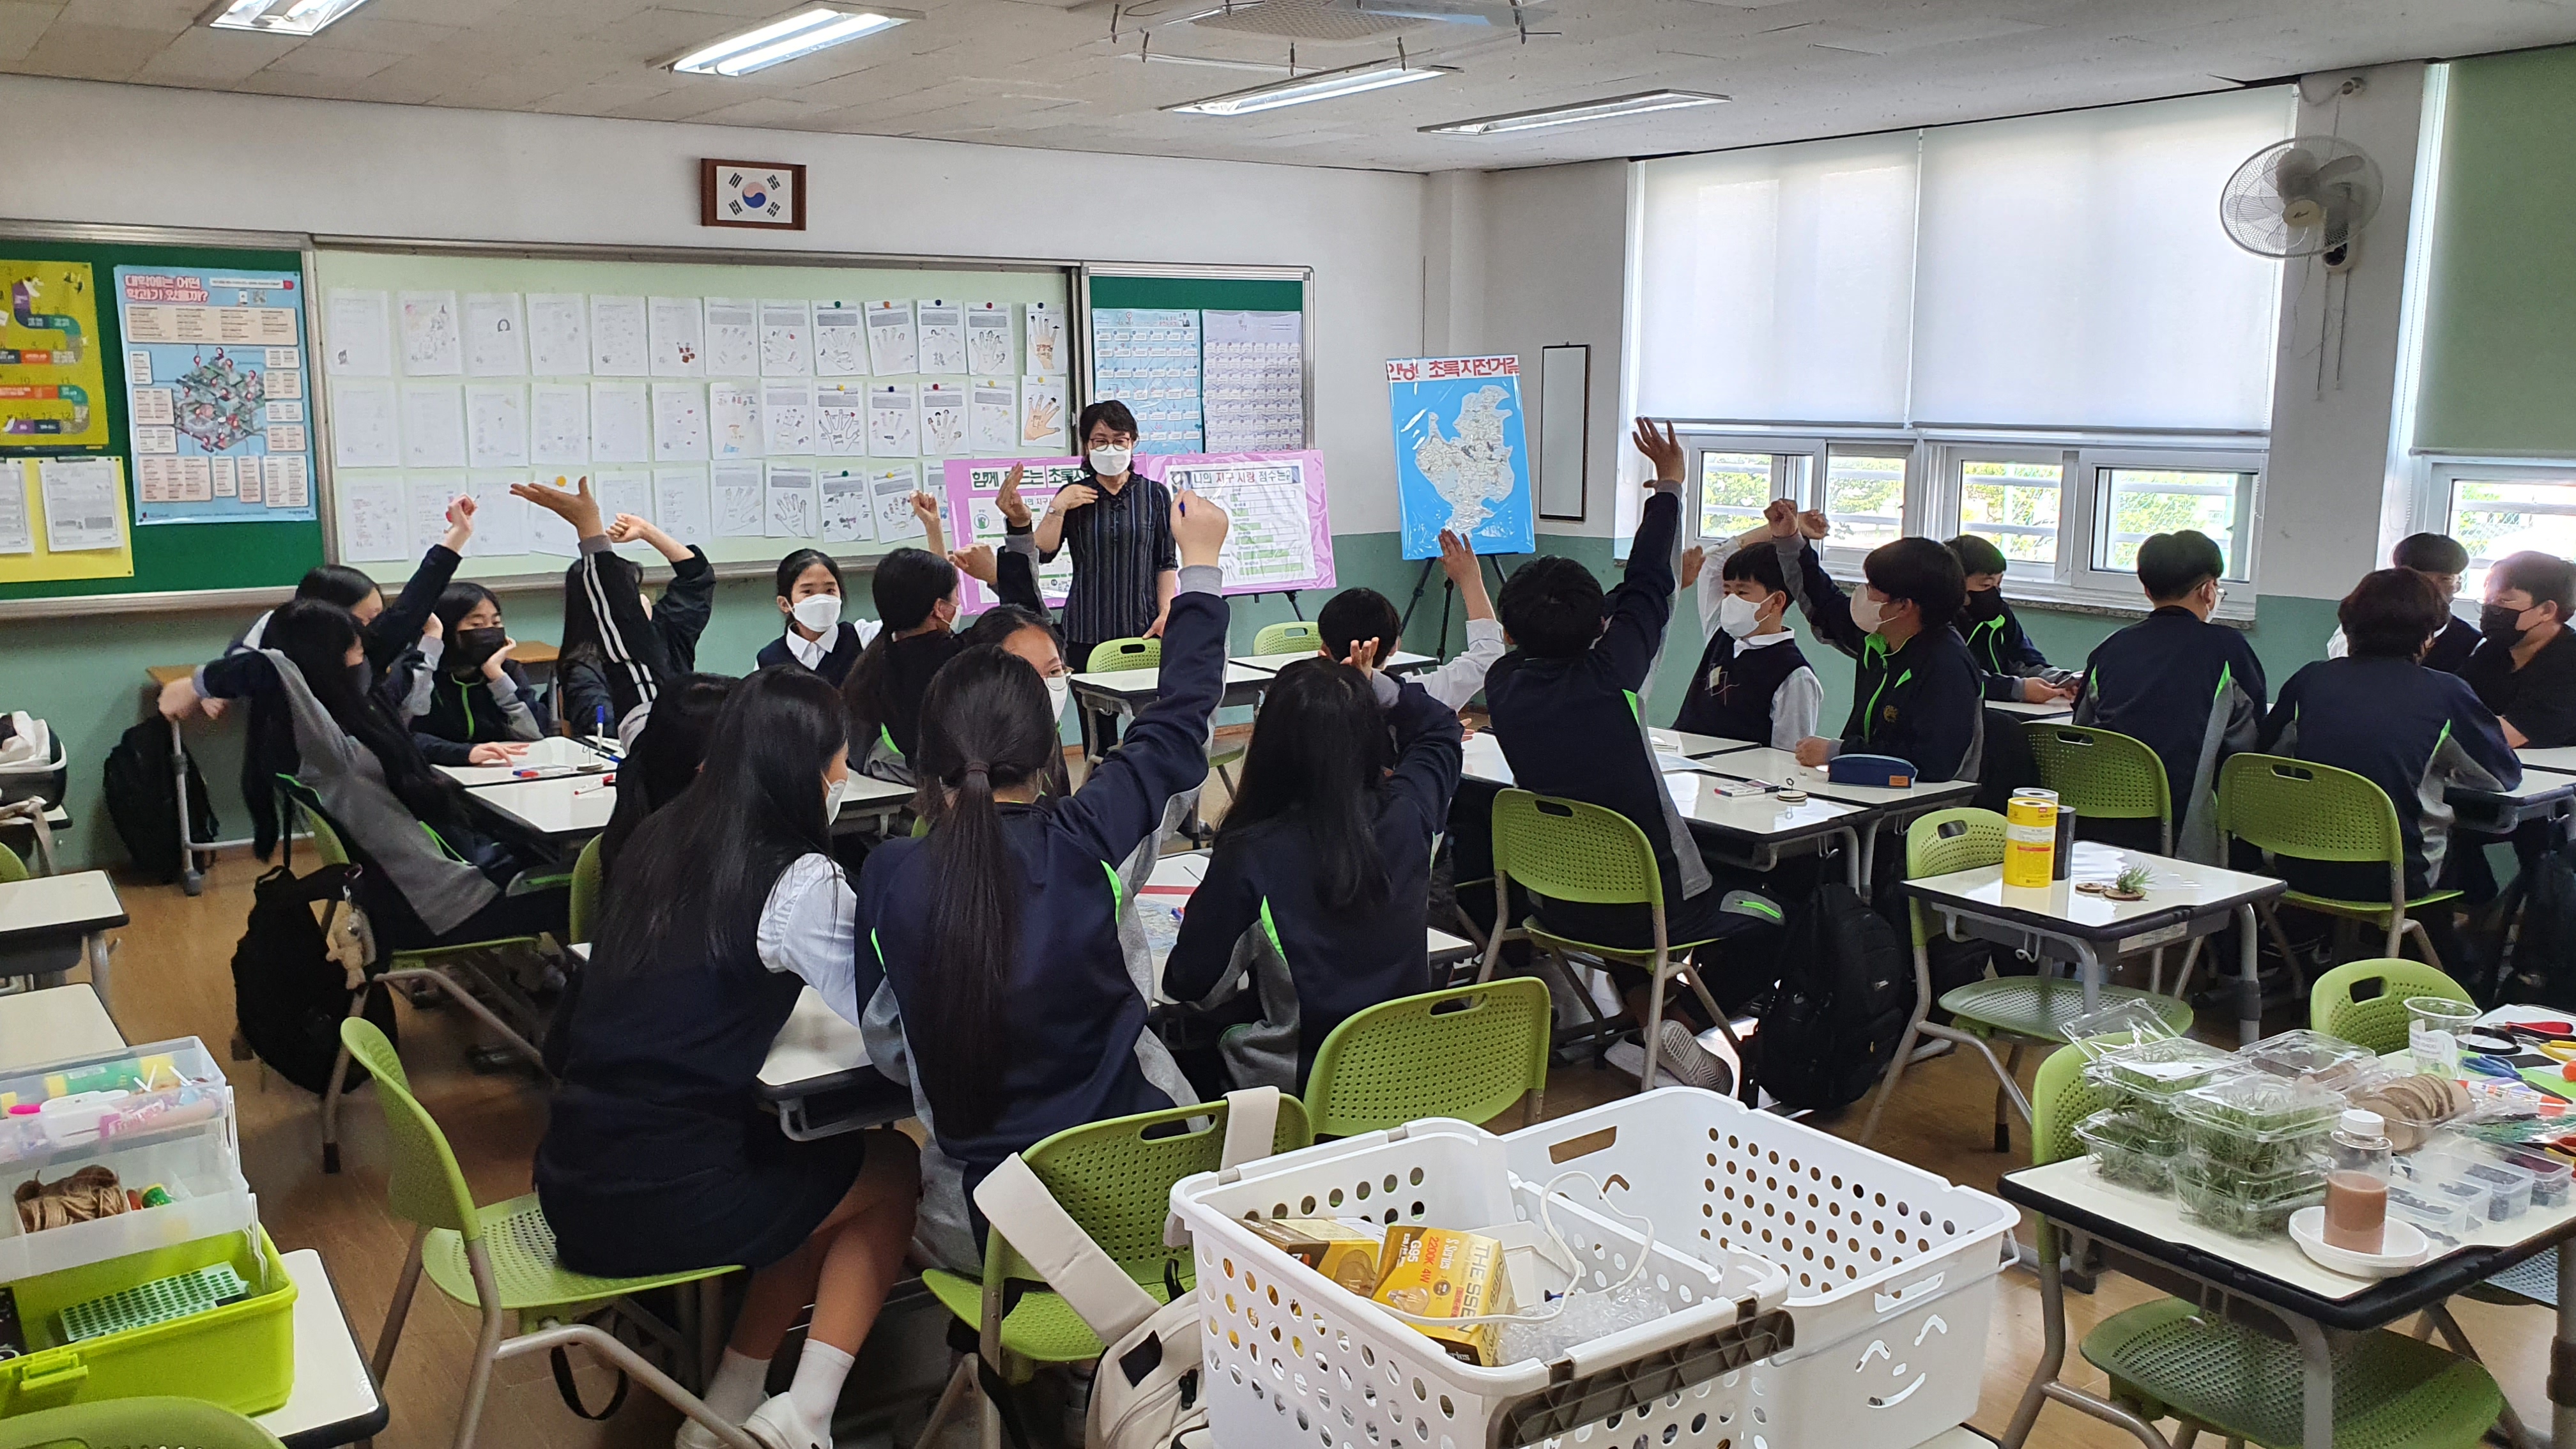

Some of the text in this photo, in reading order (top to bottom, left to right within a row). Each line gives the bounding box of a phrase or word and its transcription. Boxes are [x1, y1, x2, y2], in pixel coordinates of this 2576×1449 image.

[972, 471, 999, 487] 함께
[1193, 472, 1212, 484] 나의
[1216, 471, 1234, 484] 지구
[1407, 1239, 1422, 1262] G95
[1425, 1236, 1440, 1266] 2200K
[1439, 1246, 1458, 1270] Series
[1470, 1245, 1491, 1278] THE
